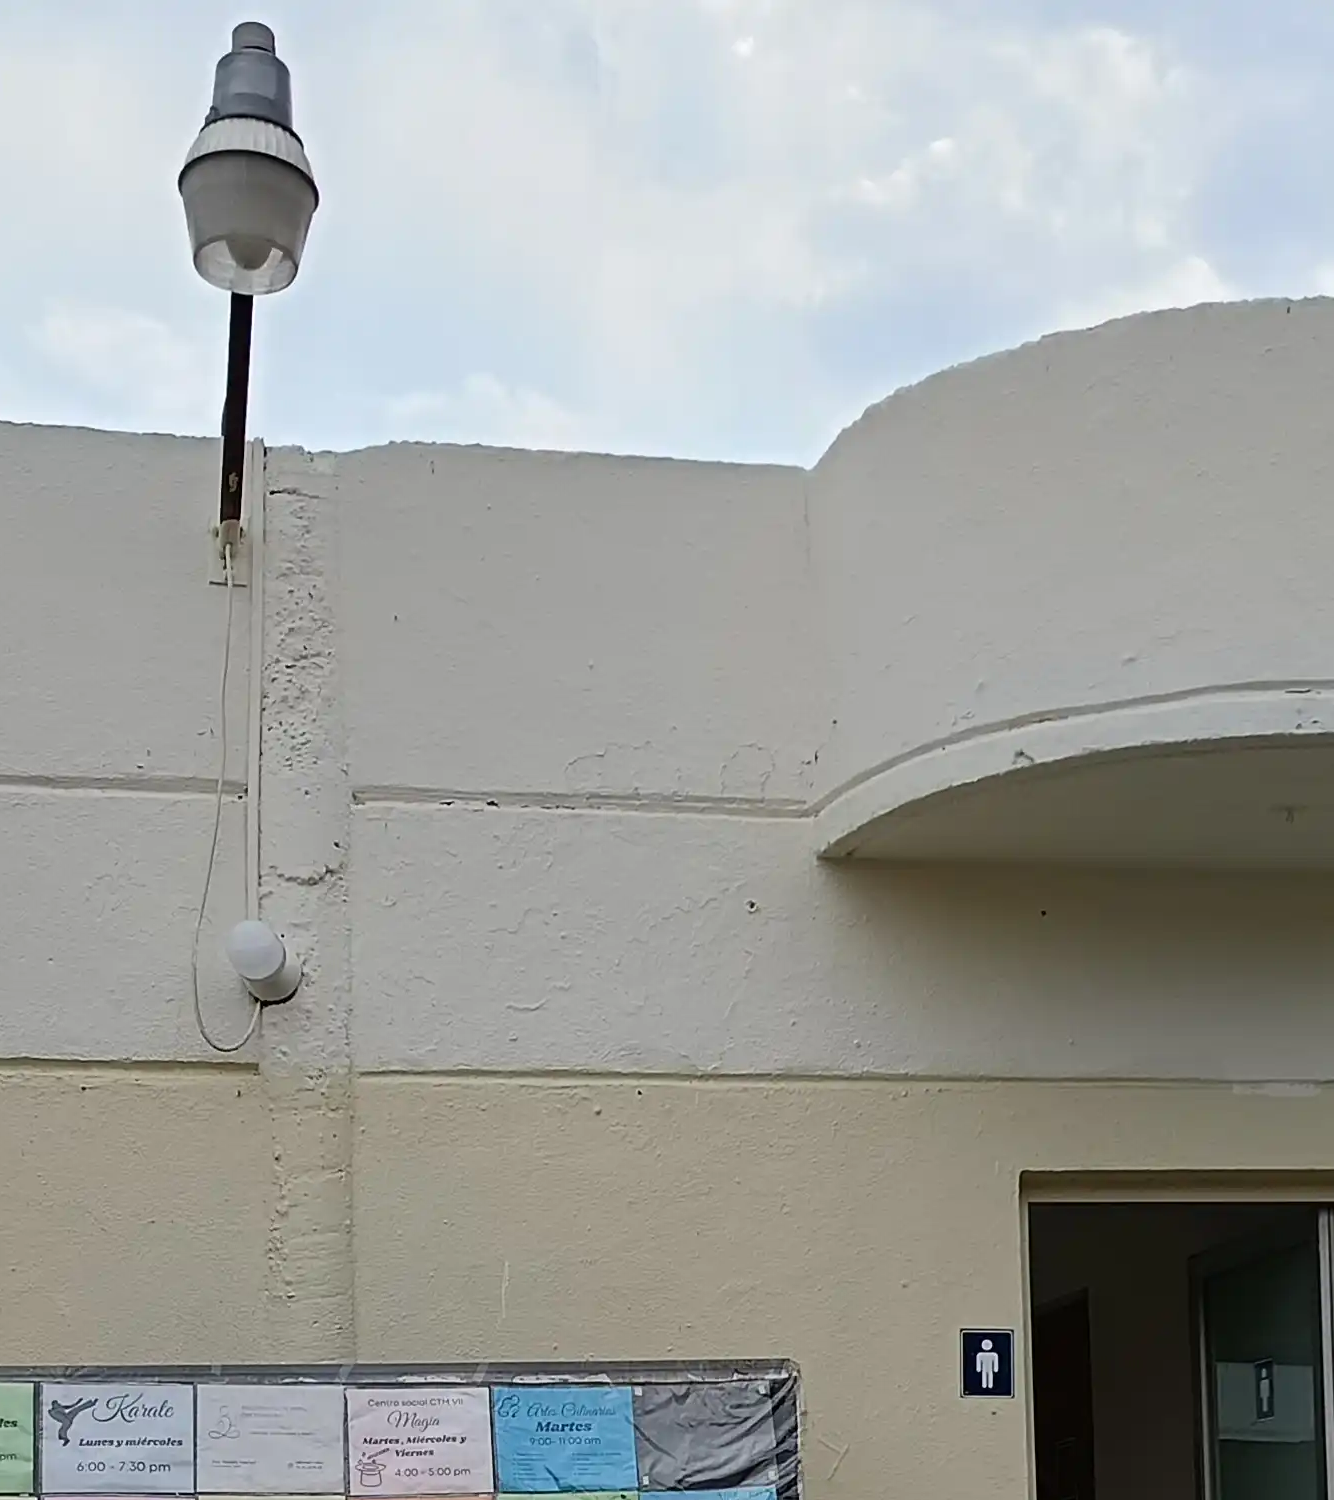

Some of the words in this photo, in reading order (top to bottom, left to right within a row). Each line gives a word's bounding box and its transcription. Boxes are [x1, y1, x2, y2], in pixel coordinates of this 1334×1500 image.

[91, 1393, 174, 1424] Karate
[367, 1398, 399, 1408] Centro
[401, 1398, 428, 1407] social
[386, 1410, 441, 1433] Magia
[535, 1420, 593, 1433] Martes
[78, 1437, 115, 1448] Lunes
[115, 1439, 124, 1450] y
[125, 1436, 184, 1448] miércoles
[362, 1435, 405, 1446] Martes,
[406, 1434, 458, 1445] Miércoles
[459, 1435, 468, 1446] y
[589, 1436, 602, 1445] am
[394, 1448, 436, 1458] Viernes
[76, 1460, 106, 1472] 6:00
[117, 1461, 146, 1472] 7:30
[148, 1463, 172, 1475] pm
[394, 1467, 419, 1477] 4:00
[453, 1467, 471, 1478] pm
